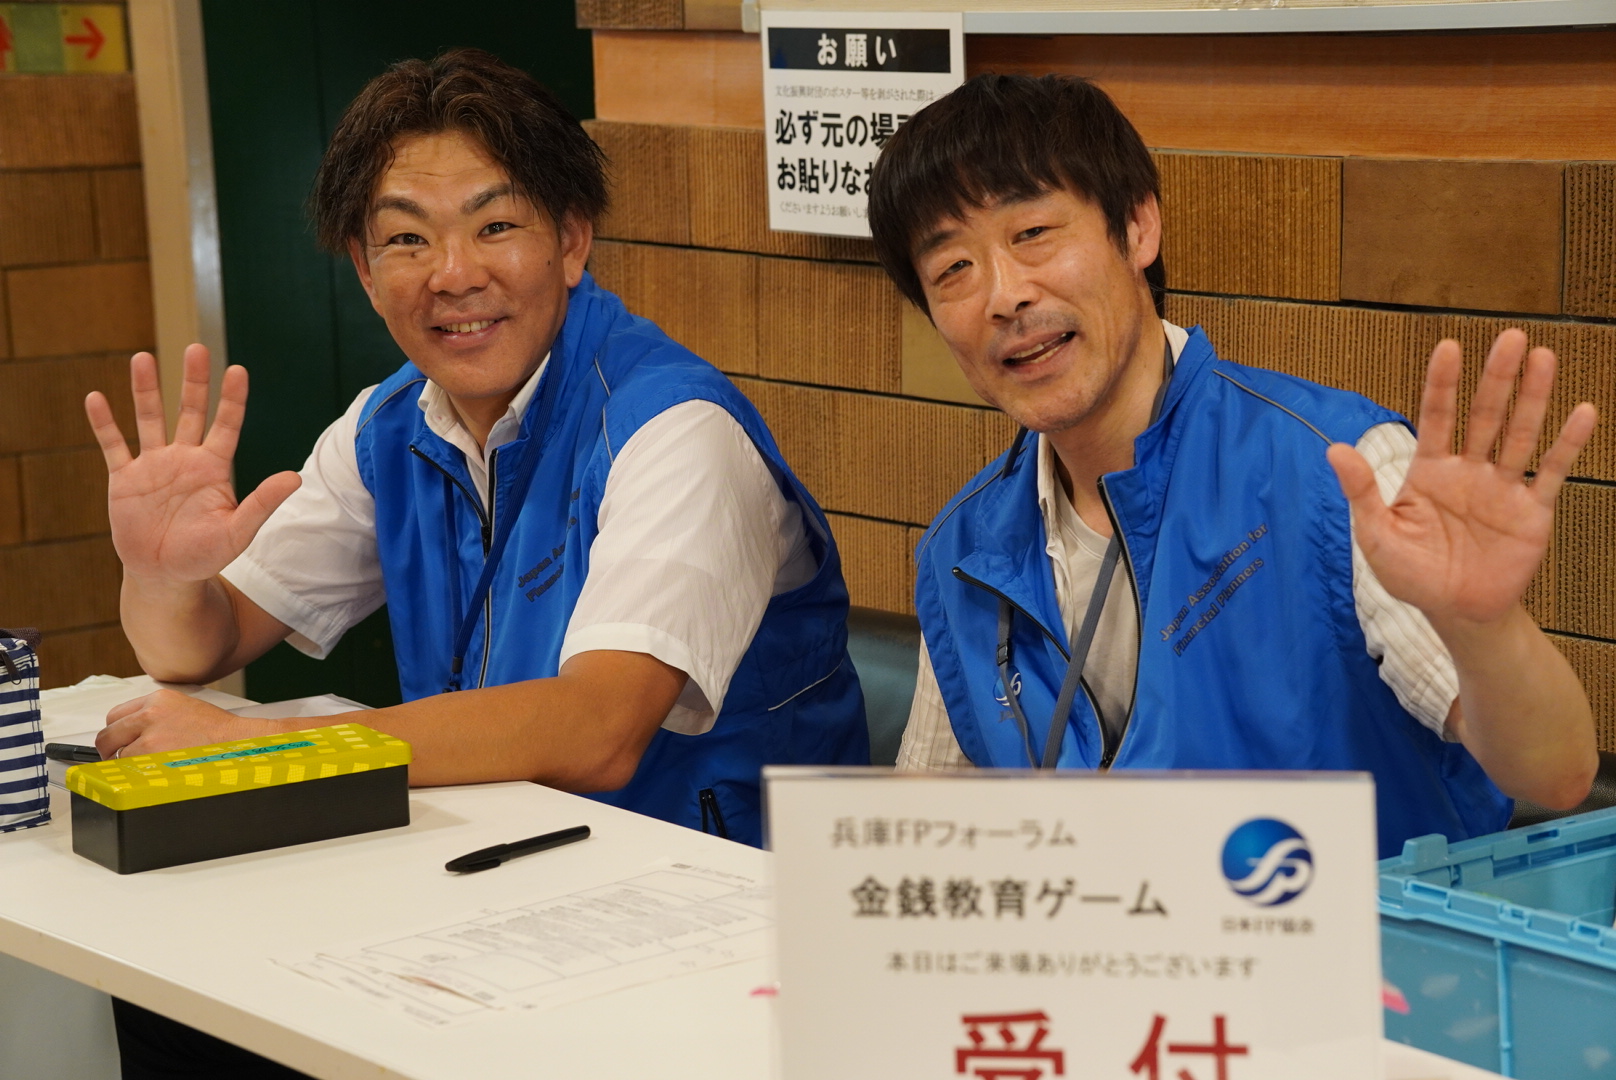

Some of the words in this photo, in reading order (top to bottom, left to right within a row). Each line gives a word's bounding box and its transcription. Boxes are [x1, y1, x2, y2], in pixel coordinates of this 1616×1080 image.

[817, 33, 897, 68] お願い
[775, 109, 911, 150] 必ず元の場
[518, 556, 553, 588] Japan
[1160, 605, 1190, 642] Japan
[1187, 540, 1250, 607] Association
[1247, 522, 1269, 544] for
[1173, 603, 1220, 657] Financial
[1216, 557, 1265, 607] Planners
[832, 818, 1076, 850] 兵庫FPフォーラム
[851, 876, 1169, 921] 金銭教育ゲーム
